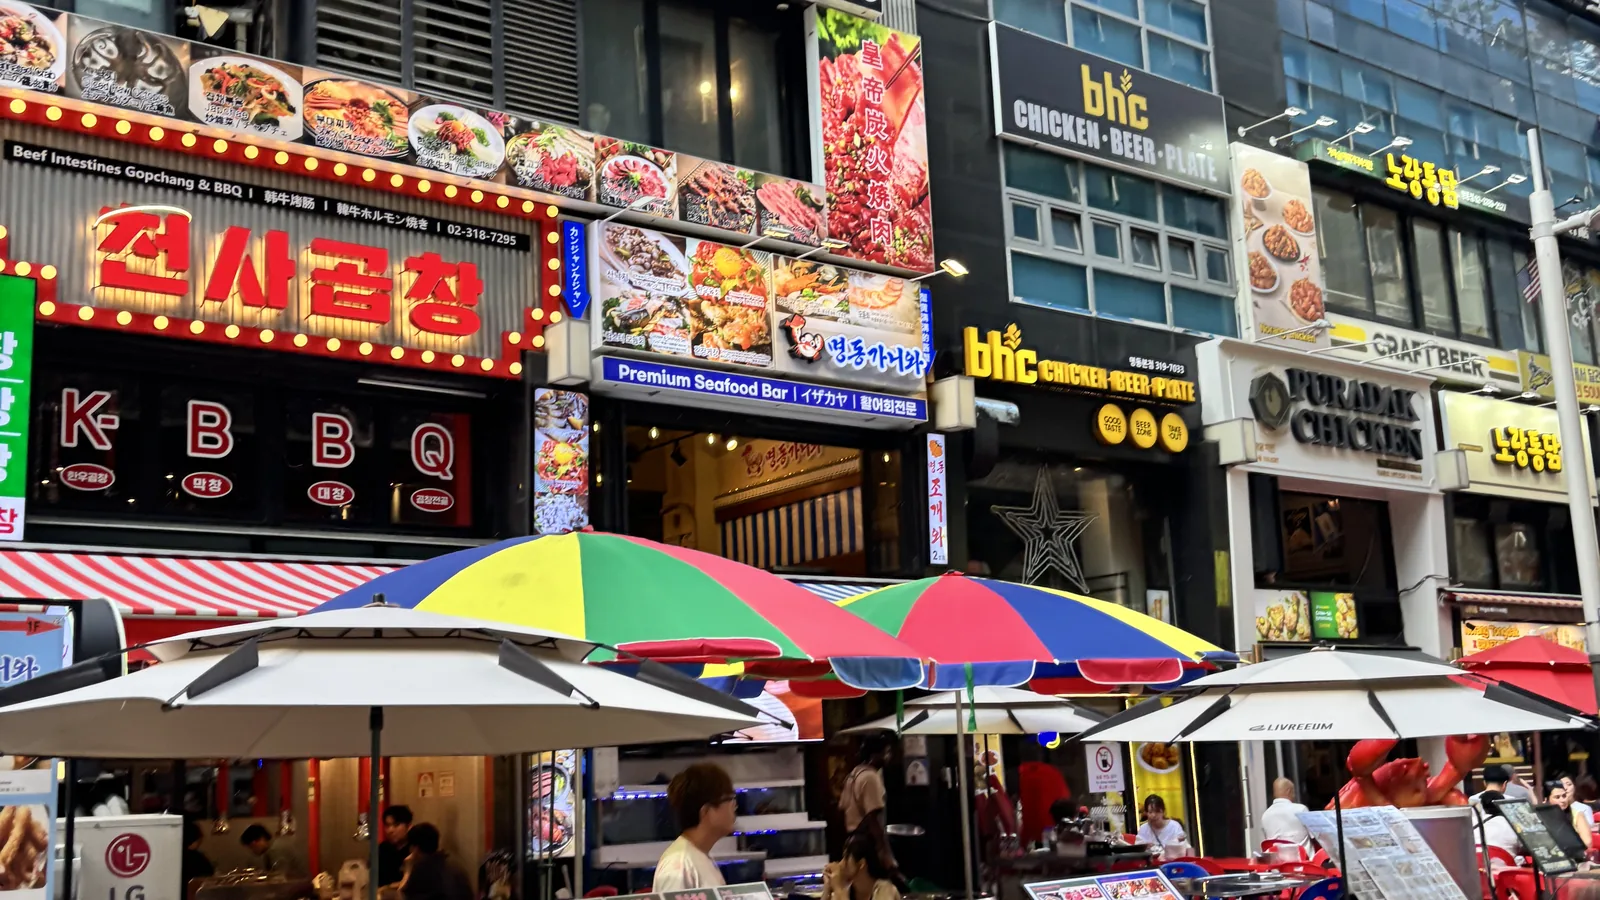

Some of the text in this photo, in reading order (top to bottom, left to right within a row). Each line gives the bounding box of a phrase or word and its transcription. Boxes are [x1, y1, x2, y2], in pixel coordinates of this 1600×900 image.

[1081, 64, 1149, 131] bhc
[862, 39, 893, 246] 皇帝炭火燒肉
[1014, 99, 1218, 182] CHICKEN BEER PLATE
[13, 145, 243, 198] Beef Intestines Gopchang & BBQ
[1384, 152, 1460, 210] 노랑통닭
[337, 202, 429, 231] 韓牛ホルモン焼き
[447, 223, 517, 246] 02-318-7295
[92, 201, 483, 337] 전사곱창
[827, 335, 926, 376] 명동가니와
[963, 325, 1038, 385] bhc
[1155, 361, 1185, 375] 319-7033
[1373, 331, 1484, 378] CRAFT BEER
[618, 363, 788, 400] Premium Seafood Bar
[801, 389, 848, 408] イザカヤ
[1037, 360, 1108, 390] CHICKEN
[1110, 370, 1151, 396] BEER
[1151, 377, 1196, 403] PLATE
[1285, 366, 1420, 423] PURADAK
[860, 395, 917, 416] 활어회전문
[1103, 415, 1122, 434] GOOD TASTE
[1135, 420, 1152, 438] BEER ZONE
[1291, 408, 1424, 462] CHICKEN
[1490, 425, 1562, 474] 노랑통닭
[192, 478, 222, 493] 막창
[317, 486, 346, 501] 대창
[929, 478, 945, 548] 조개와
[28, 620, 40, 629] 1F
[1267, 722, 1334, 731] LIVREEUM
